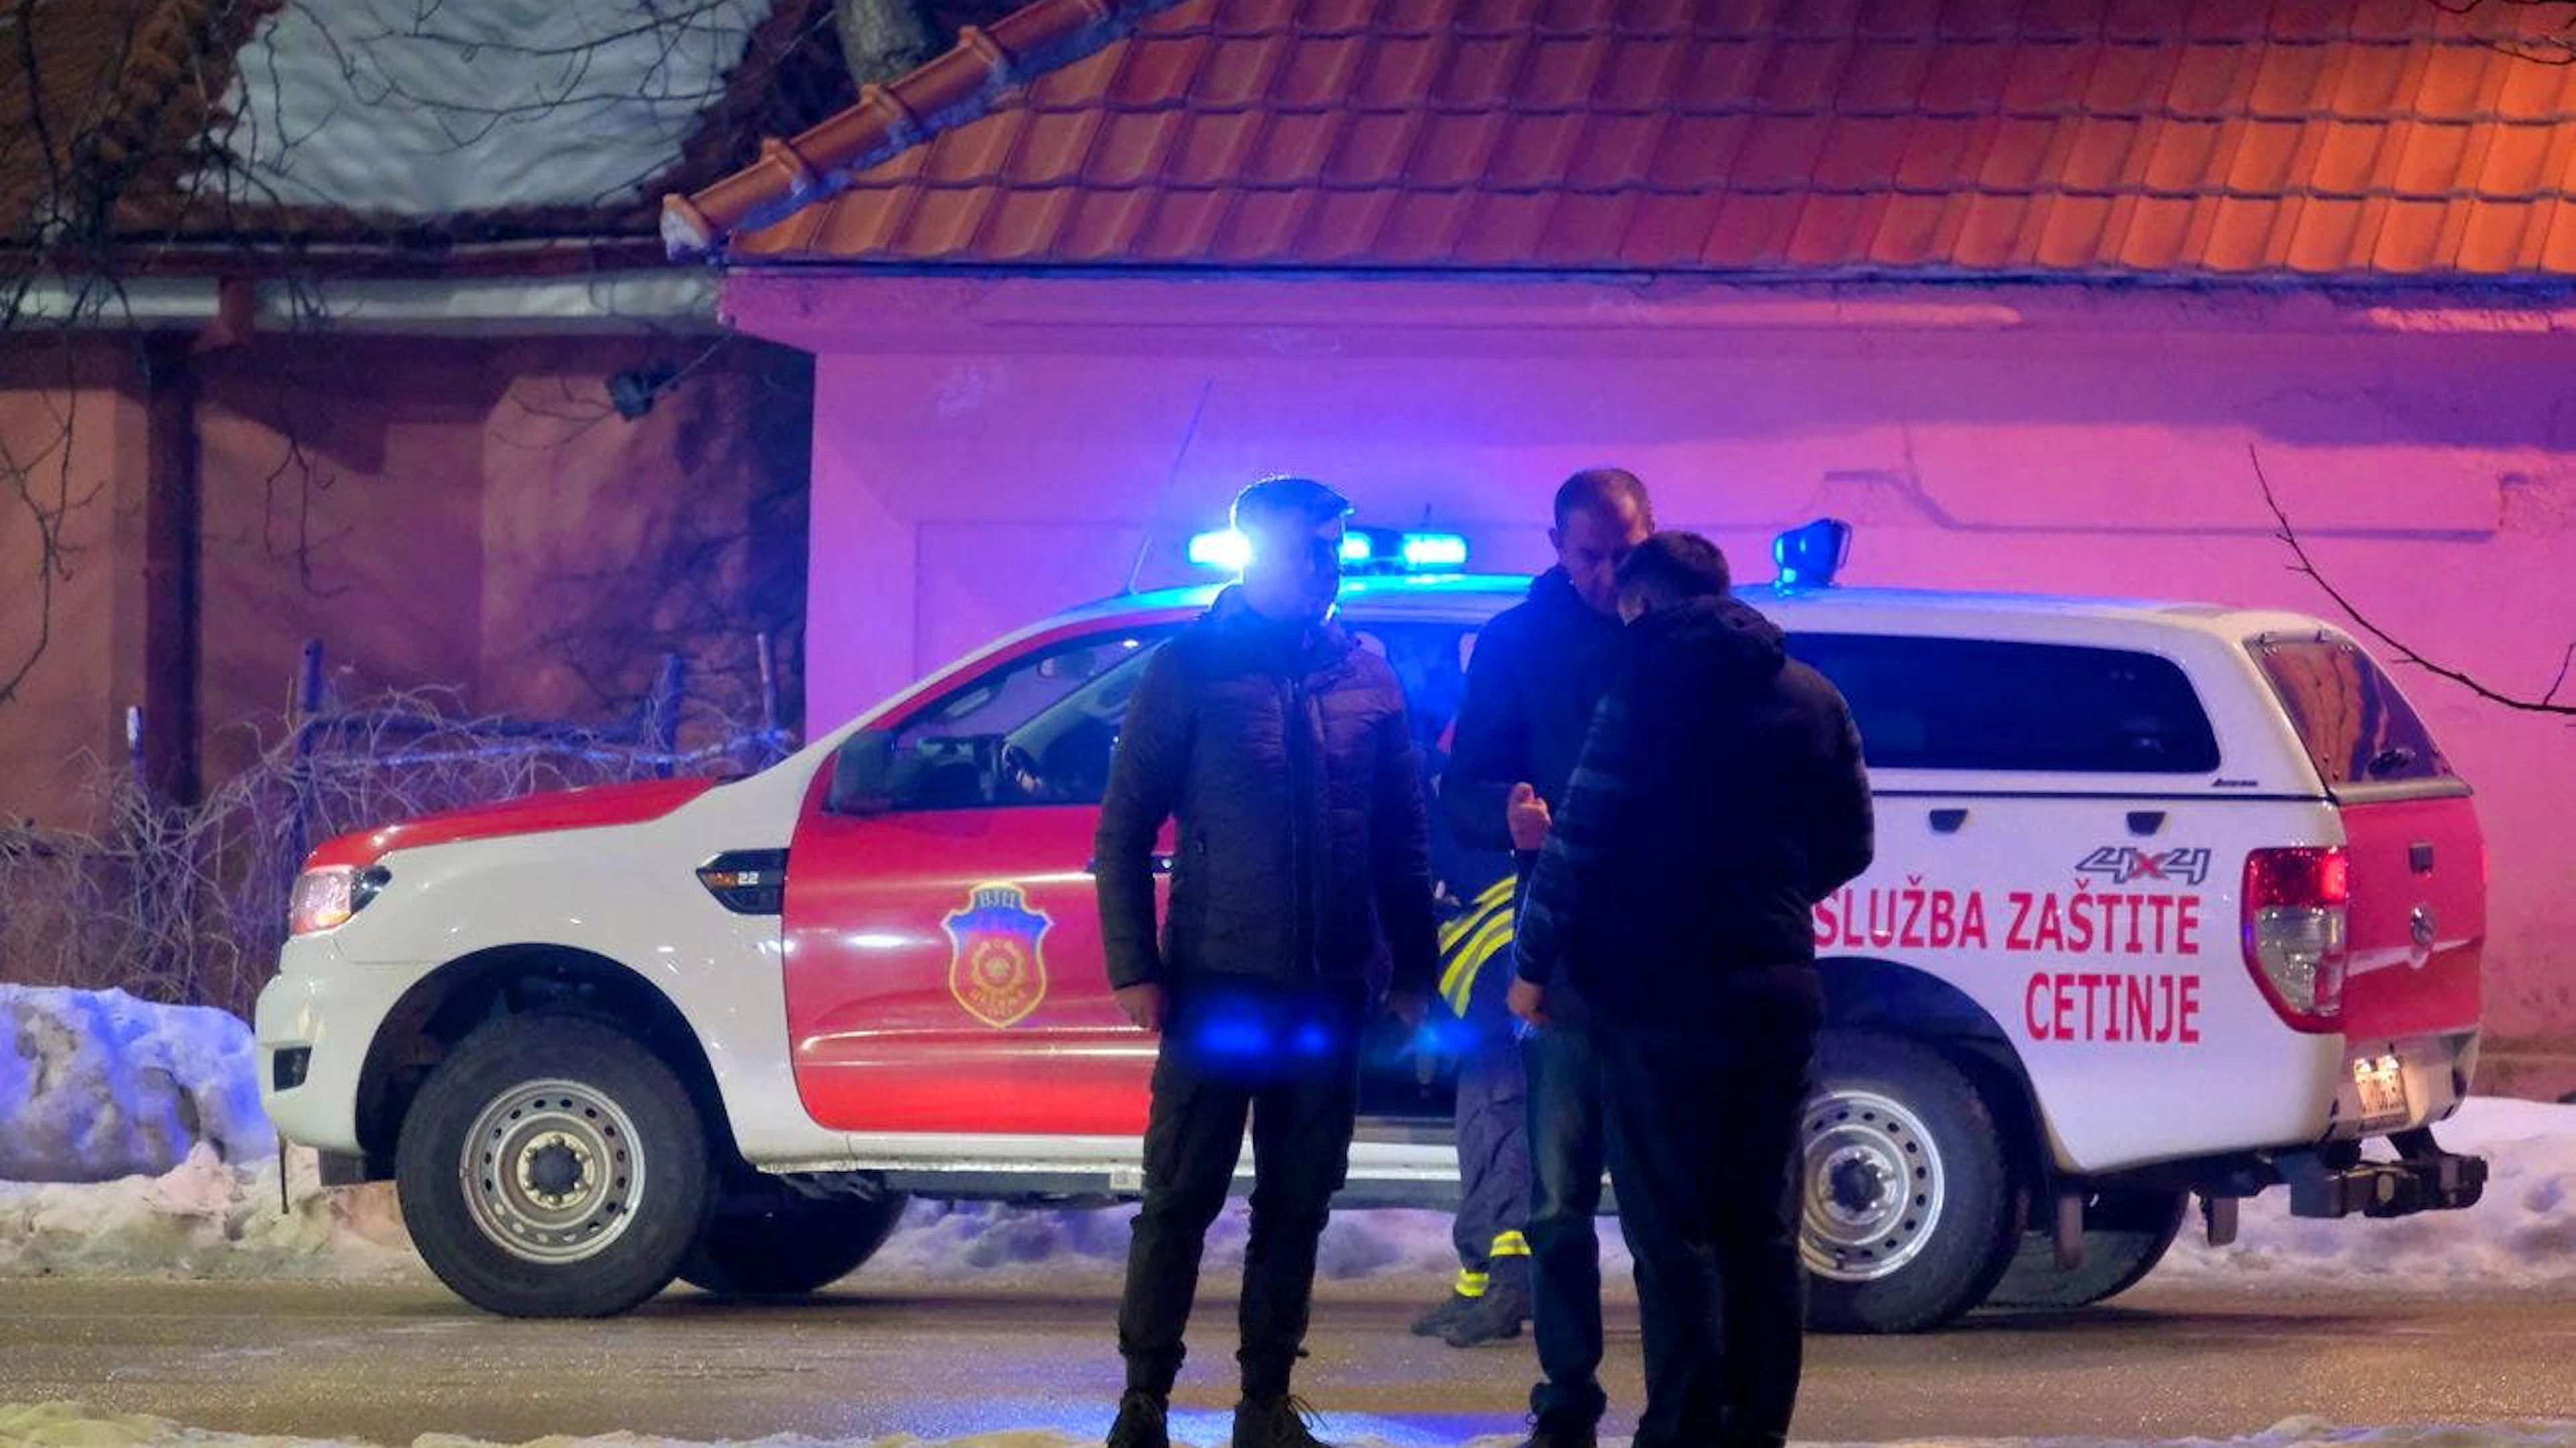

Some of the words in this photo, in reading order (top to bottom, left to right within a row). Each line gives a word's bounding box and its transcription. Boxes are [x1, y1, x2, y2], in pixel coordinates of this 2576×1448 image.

[1814, 875, 1988, 948] SLUŽBA
[2006, 878, 2200, 954] ZAŠTITE
[2025, 972, 2200, 1044] CETINJE
